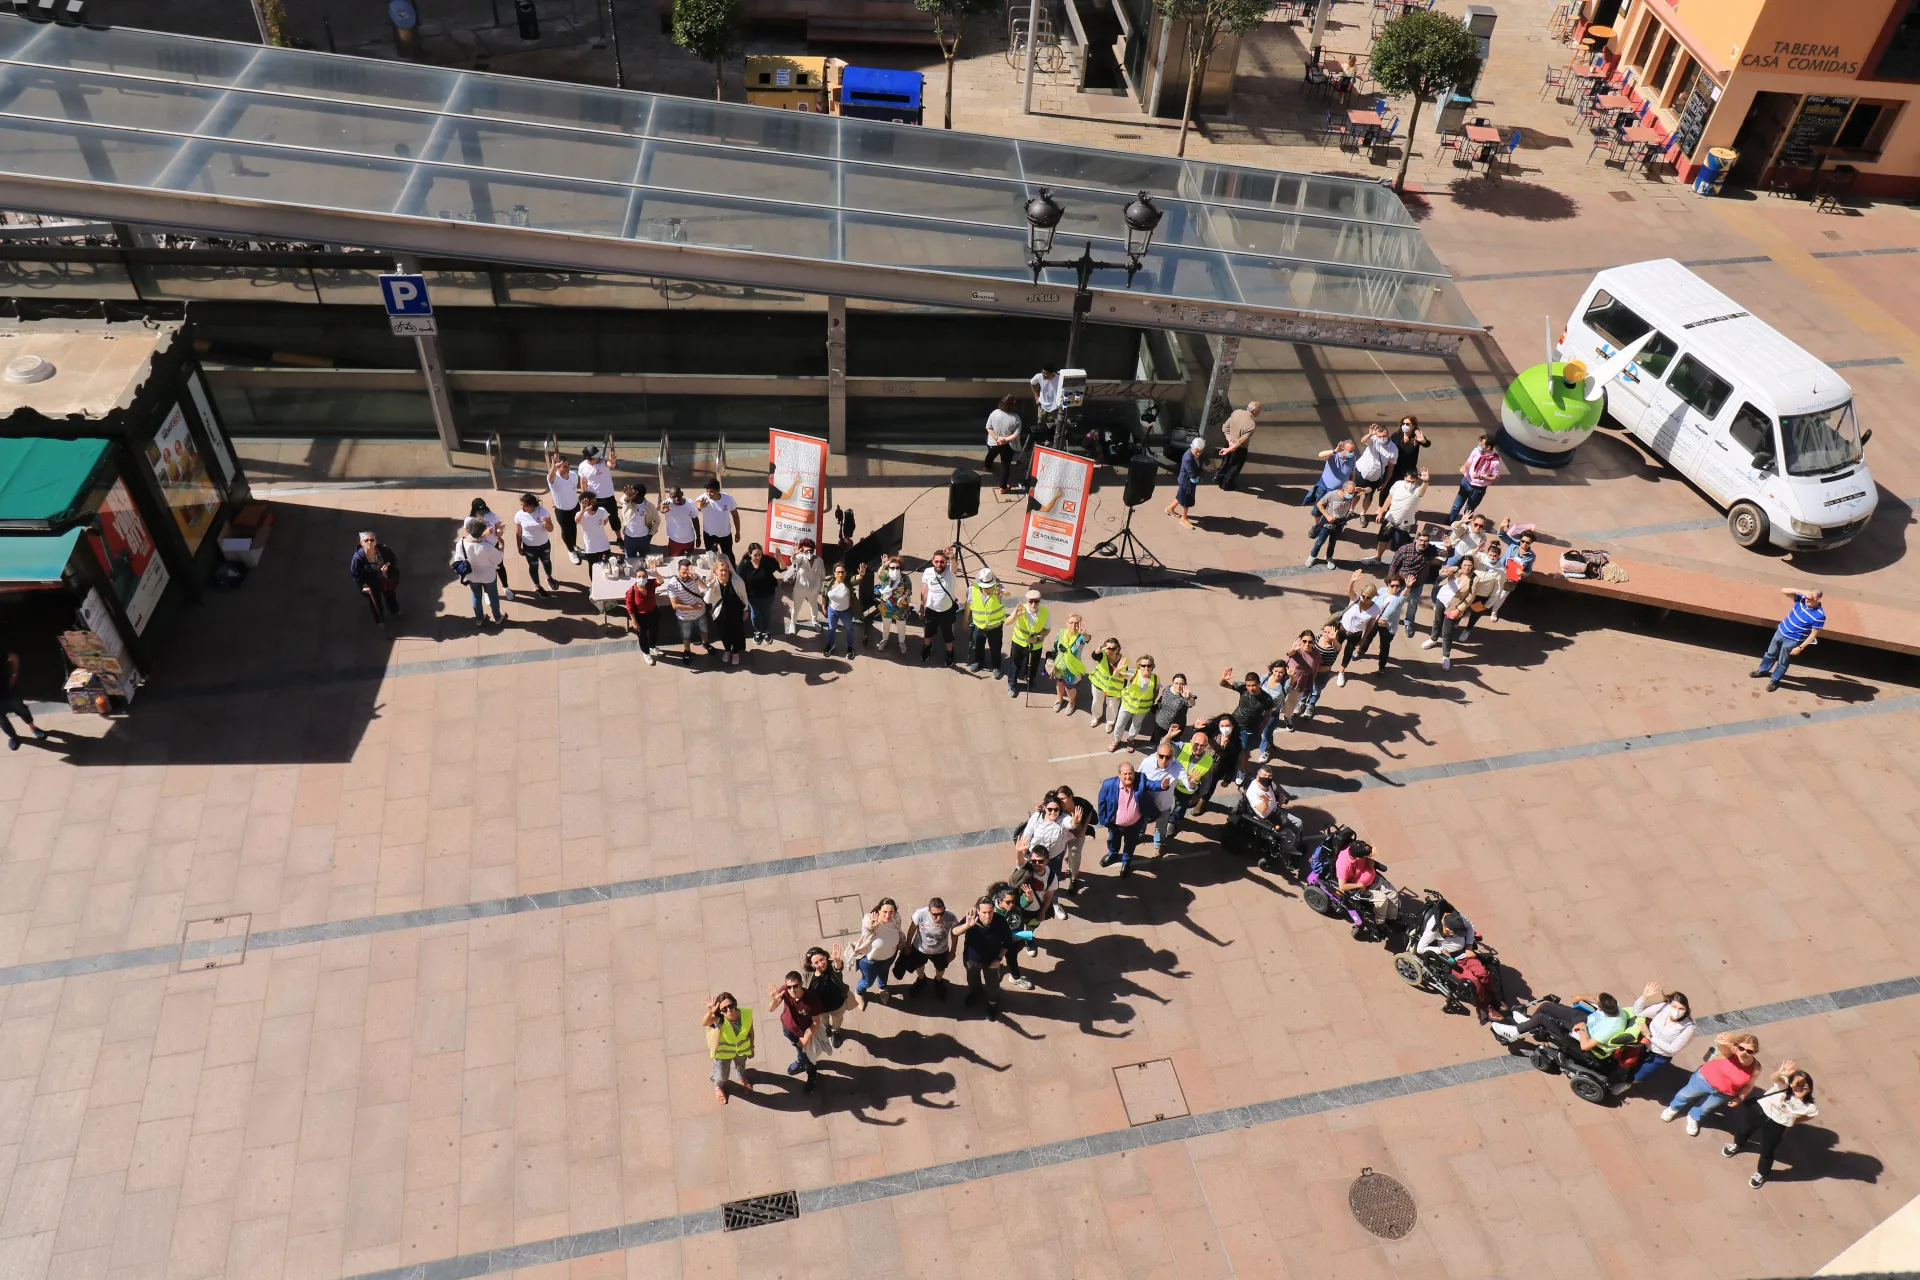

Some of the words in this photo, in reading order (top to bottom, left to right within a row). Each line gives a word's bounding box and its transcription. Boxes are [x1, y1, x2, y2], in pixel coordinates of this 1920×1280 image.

[1773, 41, 1840, 57] TABERNA
[1741, 54, 1779, 68] CASA
[1787, 57, 1859, 74] COMIDAS
[390, 281, 418, 310] P
[126, 516, 146, 554] CITY
[783, 523, 812, 533] SOLIDARIA
[1040, 533, 1069, 545] SOLIDARIA
